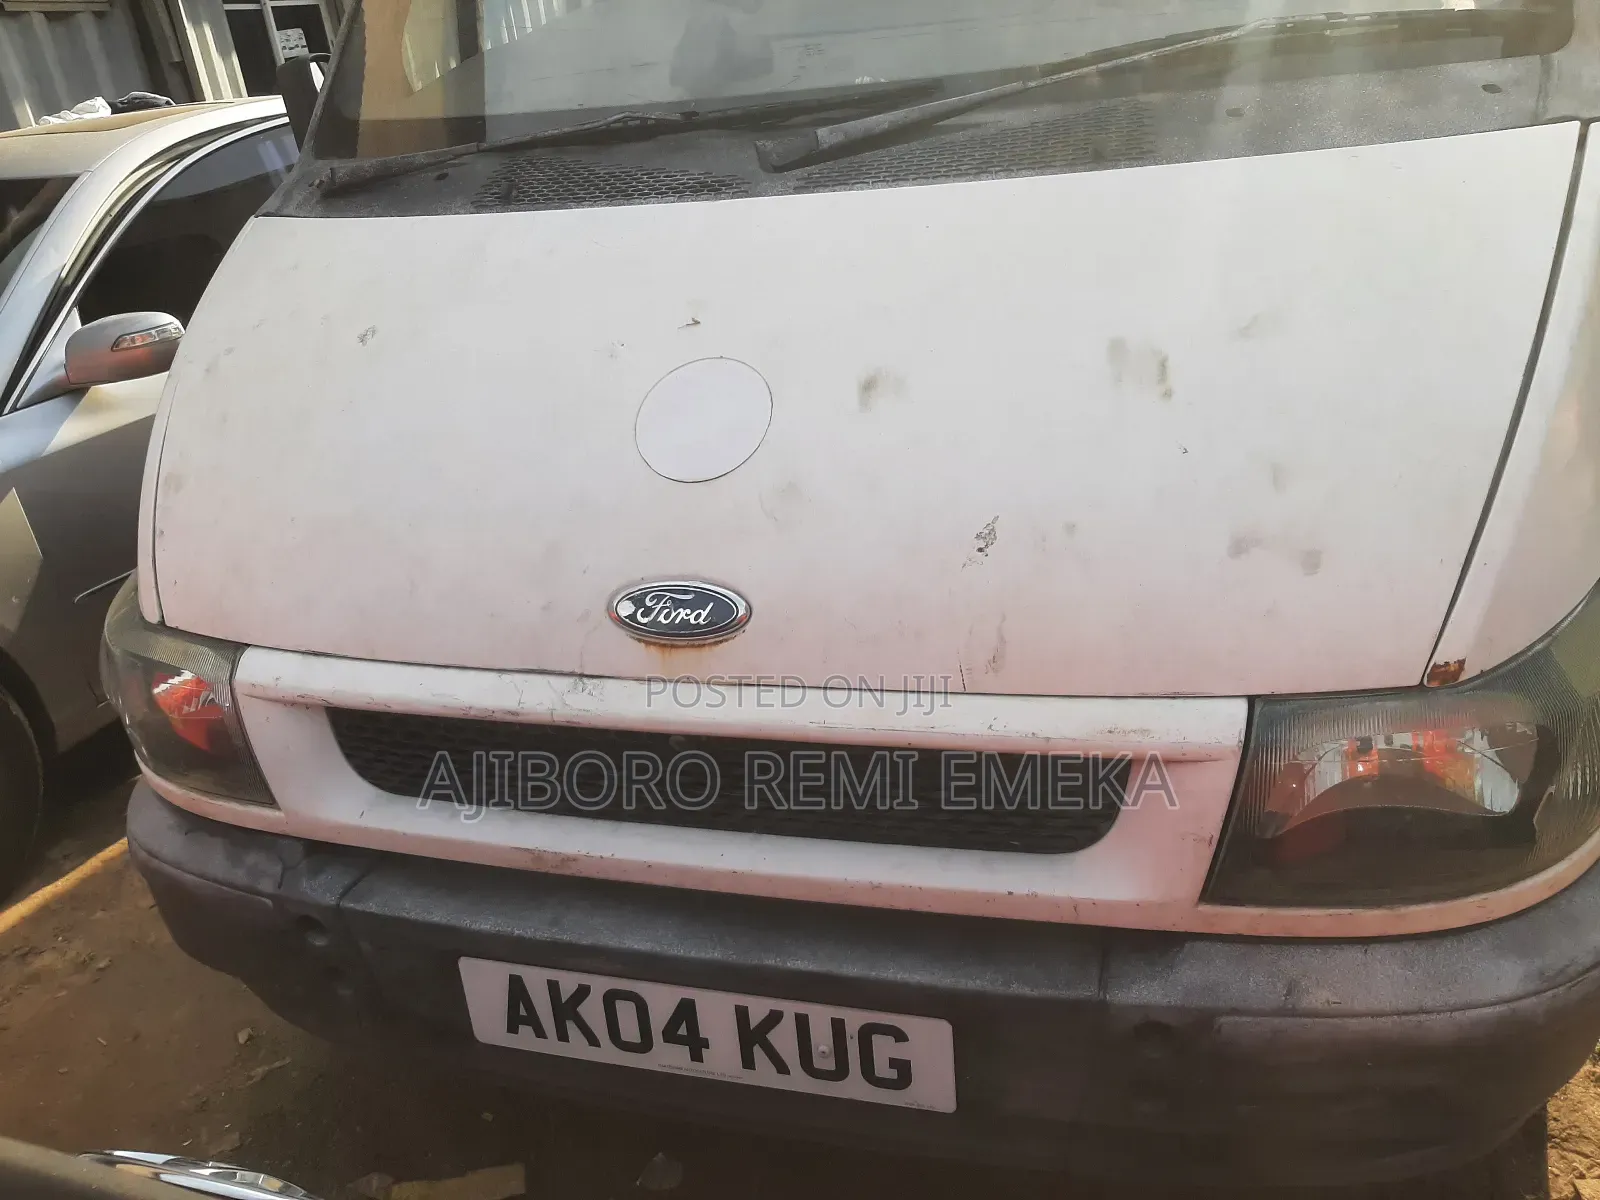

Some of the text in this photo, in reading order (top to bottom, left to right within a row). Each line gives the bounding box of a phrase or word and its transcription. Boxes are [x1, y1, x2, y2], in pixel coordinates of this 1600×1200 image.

[636, 591, 714, 625] Ford
[505, 973, 913, 1091] AK04 KUG
